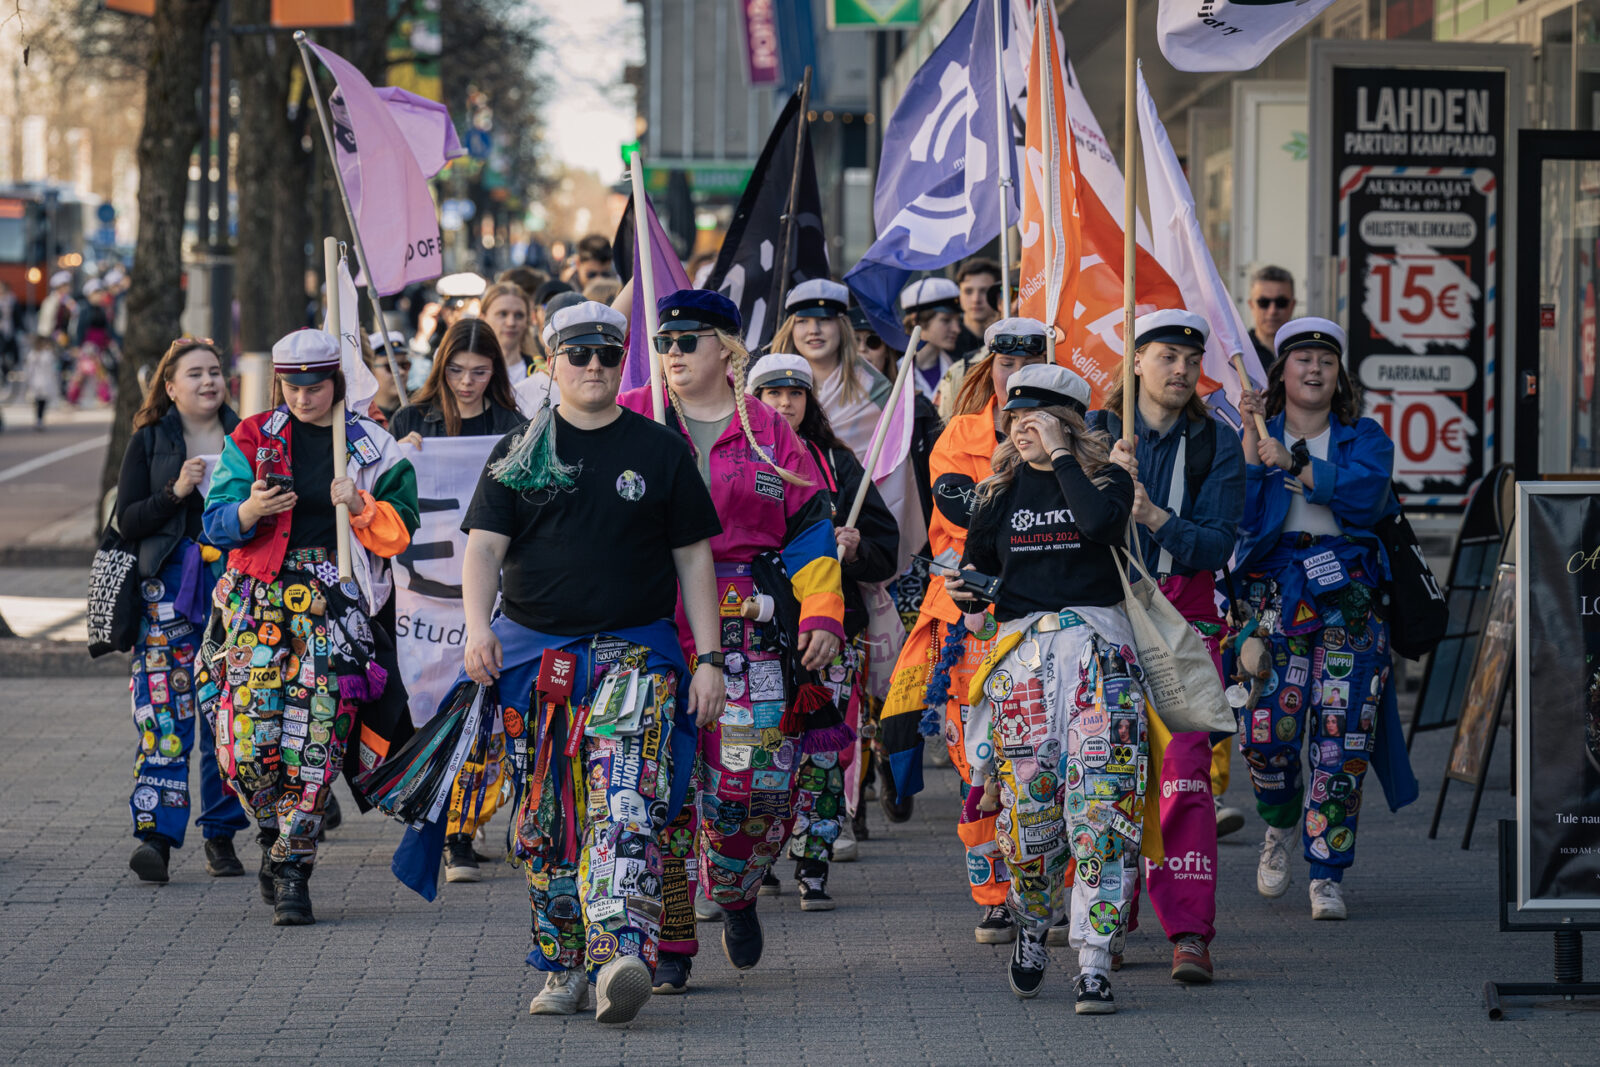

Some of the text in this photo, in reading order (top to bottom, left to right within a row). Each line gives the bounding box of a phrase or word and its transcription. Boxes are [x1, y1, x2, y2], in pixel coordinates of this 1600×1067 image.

[1357, 87, 1490, 134] LAHDEN
[1345, 134, 1497, 157] PARTURI KAMPAAMO
[1366, 181, 1472, 196] AUKIOLOAJAT
[1380, 198, 1461, 211] Ma-La 09-19
[1365, 221, 1472, 239] HIUSTENLEIKKAUS
[417, 238, 435, 258] OF
[1370, 265, 1460, 325] 15€
[1379, 365, 1451, 382] PARRANAJO
[757, 484, 782, 497] LAHEST
[1035, 509, 1075, 526] LTKY
[1010, 531, 1079, 545] HALLITUS 2024
[395, 615, 468, 646] Stud
[1328, 656, 1352, 667] VAPPU
[550, 676, 568, 687] Tehy
[1003, 702, 1018, 710] ABB
[466, 716, 475, 731] LTKY
[453, 752, 461, 766] LTKY
[1555, 813, 1579, 824] Tule
[1029, 841, 1058, 853] VANTAA
[1560, 847, 1592, 856] 10.30 AM
